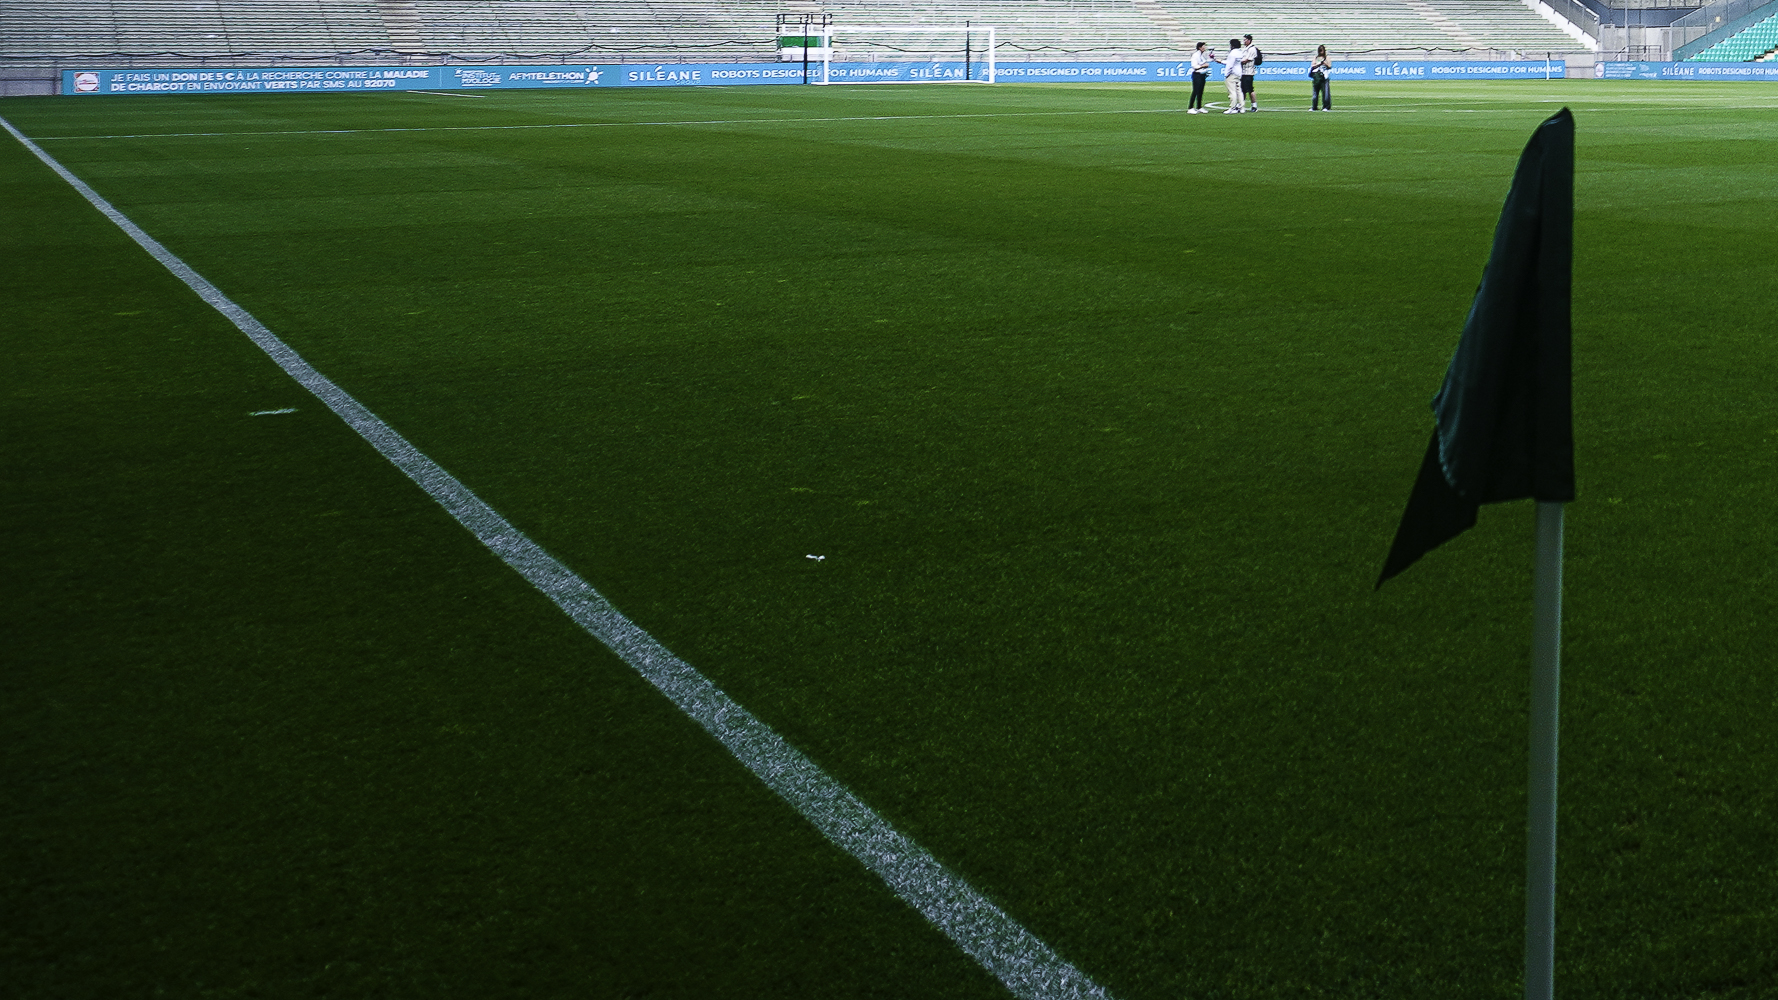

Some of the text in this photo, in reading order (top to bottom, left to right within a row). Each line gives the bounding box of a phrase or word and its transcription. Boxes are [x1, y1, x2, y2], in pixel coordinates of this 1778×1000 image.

[711, 69, 759, 78] ROBOTS
[762, 69, 821, 78] DESIGNED
[849, 67, 899, 77] HUMANS
[1027, 68, 1079, 76] DESIGNED
[1080, 68, 1102, 76] FOR
[1103, 67, 1147, 76] HUMANS
[1260, 67, 1305, 75] DESIGNED
[1431, 66, 1466, 74] ROBOTS
[1467, 66, 1507, 74] DESIGNED
[1509, 66, 1526, 74] FOR
[1699, 67, 1722, 75] ROBOTS
[1722, 67, 1751, 75] DESIGNED
[1752, 67, 1764, 75] FOR
[111, 73, 124, 82] JE
[126, 73, 150, 82] FAIS
[153, 72, 169, 81] UN
[171, 72, 197, 81] DON
[200, 72, 215, 81] DE
[216, 72, 224, 81] 5
[246, 72, 259, 80] LA
[261, 71, 324, 80] RECHERCHE
[325, 71, 368, 79] CONTRE
[369, 70, 382, 79] LA
[383, 70, 429, 79] MALADIE
[111, 79, 396, 92] DE CHARCOT EN ENVOYANT VERTS PAR SMS AU 92070
